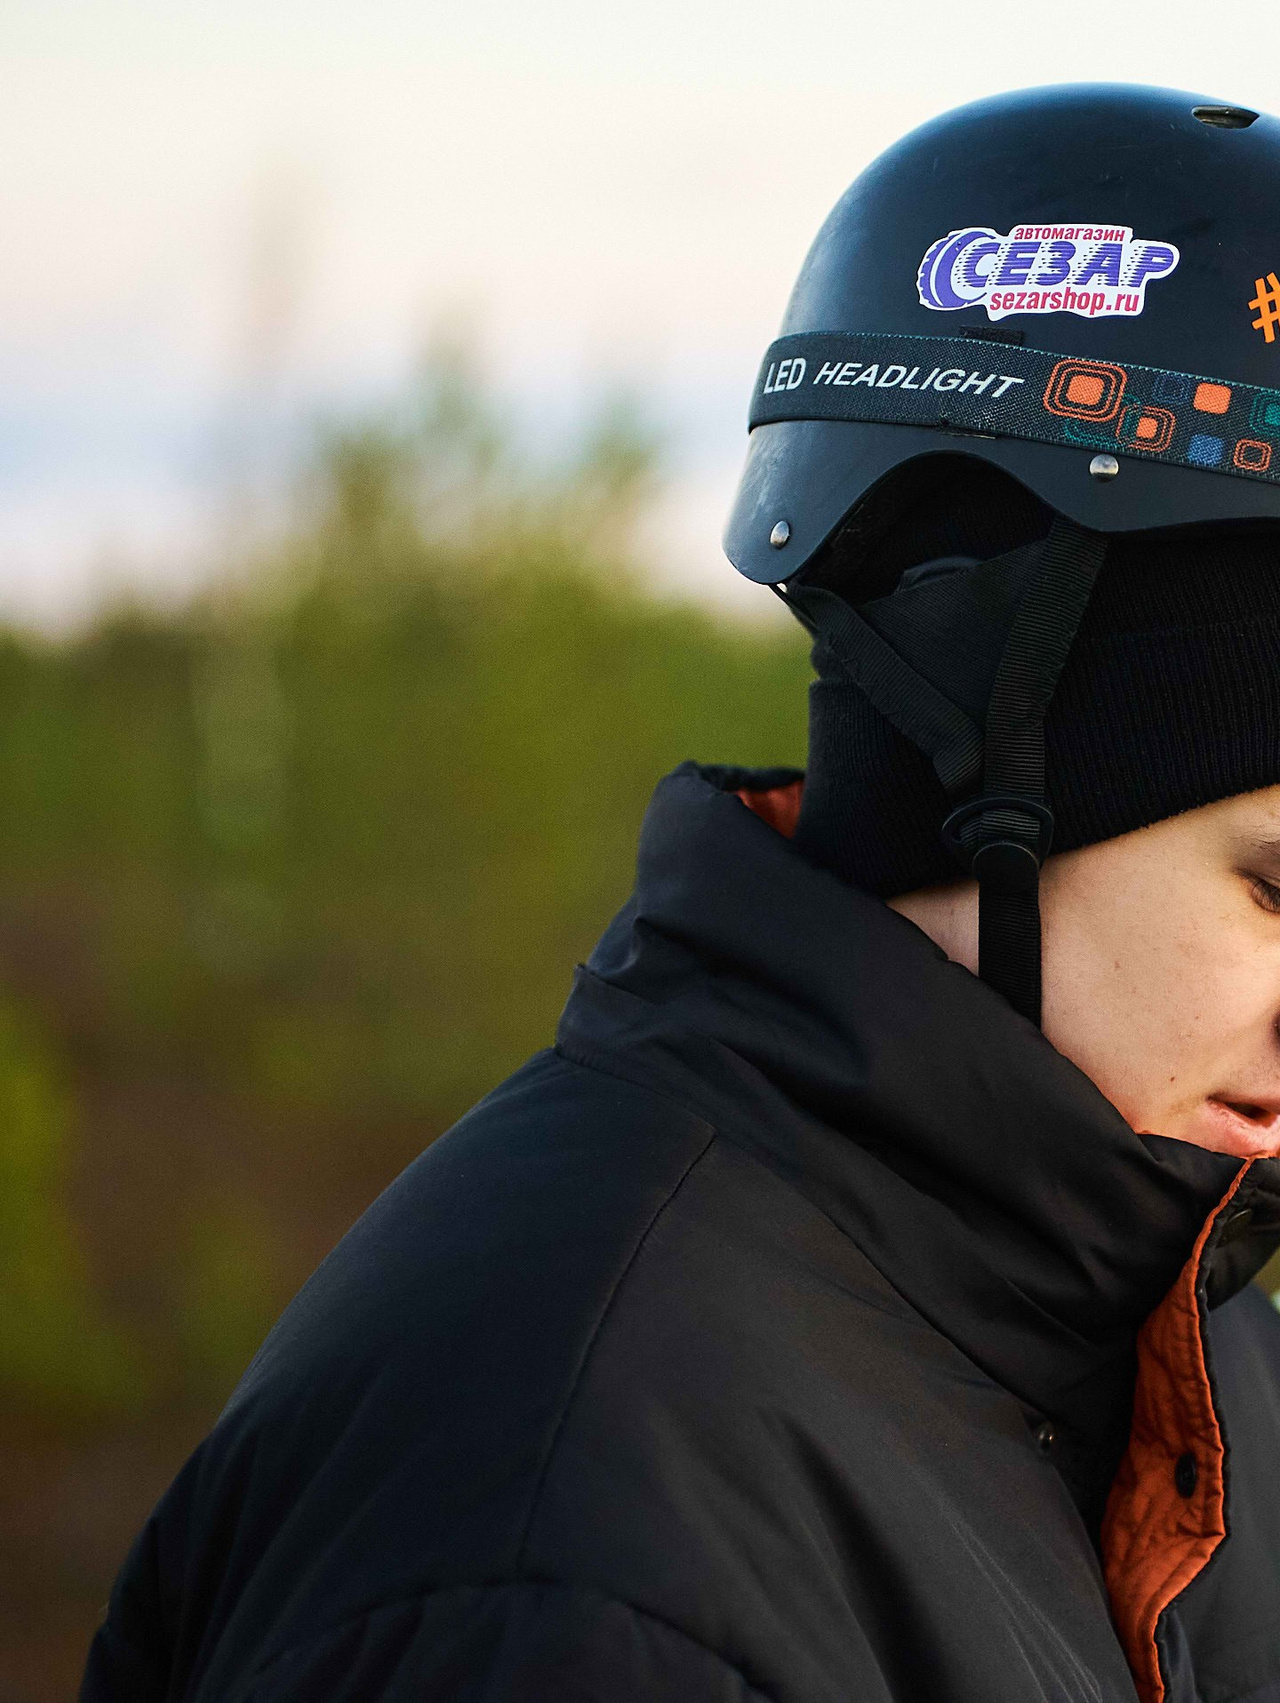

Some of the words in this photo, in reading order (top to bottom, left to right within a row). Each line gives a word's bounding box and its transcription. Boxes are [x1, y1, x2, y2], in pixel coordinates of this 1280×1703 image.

[1013, 227, 1125, 242] автомагазин
[954, 241, 1175, 288] СЕЗАР
[990, 287, 1140, 316] sezarshop.ru
[763, 357, 807, 394] LED
[812, 361, 1025, 399] HEADLIGHT
